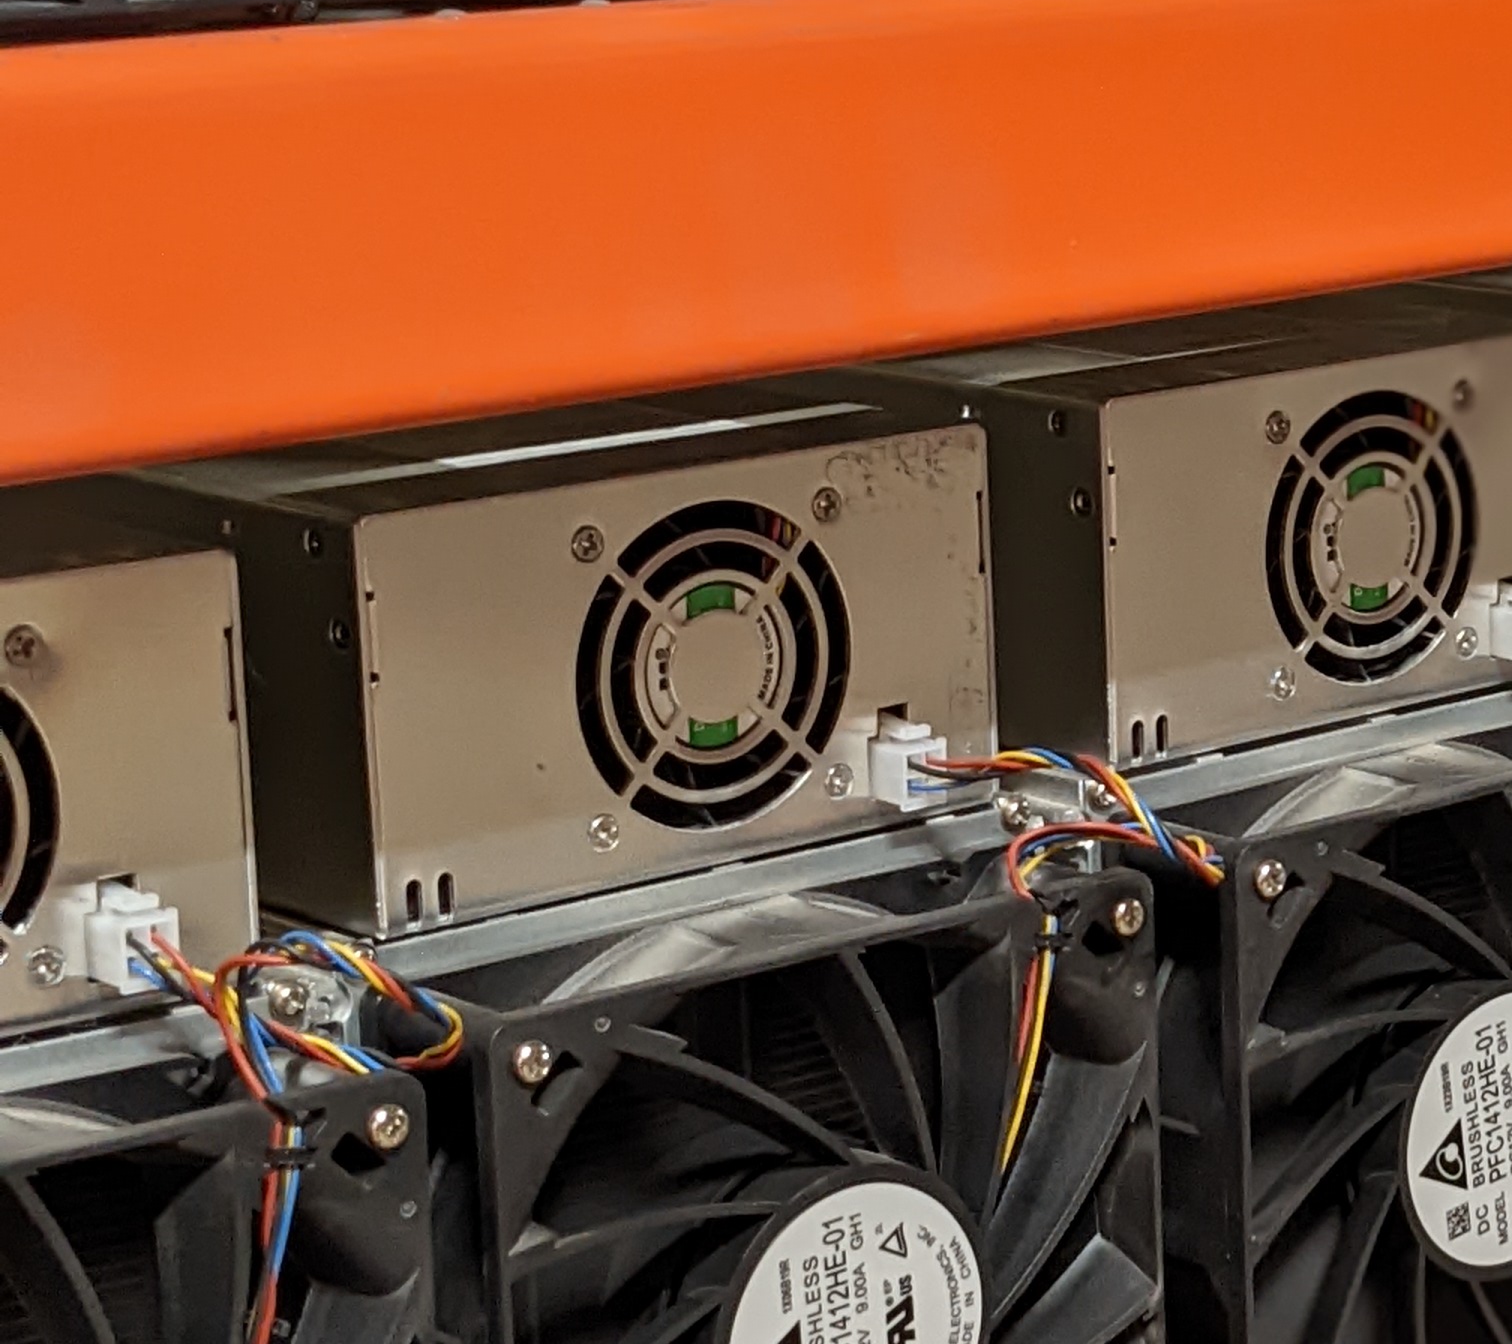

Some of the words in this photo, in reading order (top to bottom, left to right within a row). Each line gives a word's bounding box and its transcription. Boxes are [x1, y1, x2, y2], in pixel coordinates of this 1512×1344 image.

[1496, 1020, 1508, 1053] GH1
[1461, 1060, 1485, 1187] BRUSHLESS
[1475, 1024, 1507, 1183] PFC1412HE-01
[849, 1212, 864, 1250] GH1
[916, 1224, 937, 1247] INC.
[1476, 1204, 1490, 1236] DC
[1494, 1192, 1508, 1245] MODEL
[949, 1236, 972, 1278] CHINA
[854, 1262, 869, 1313] 9.00A
[963, 1291, 974, 1307] IN
